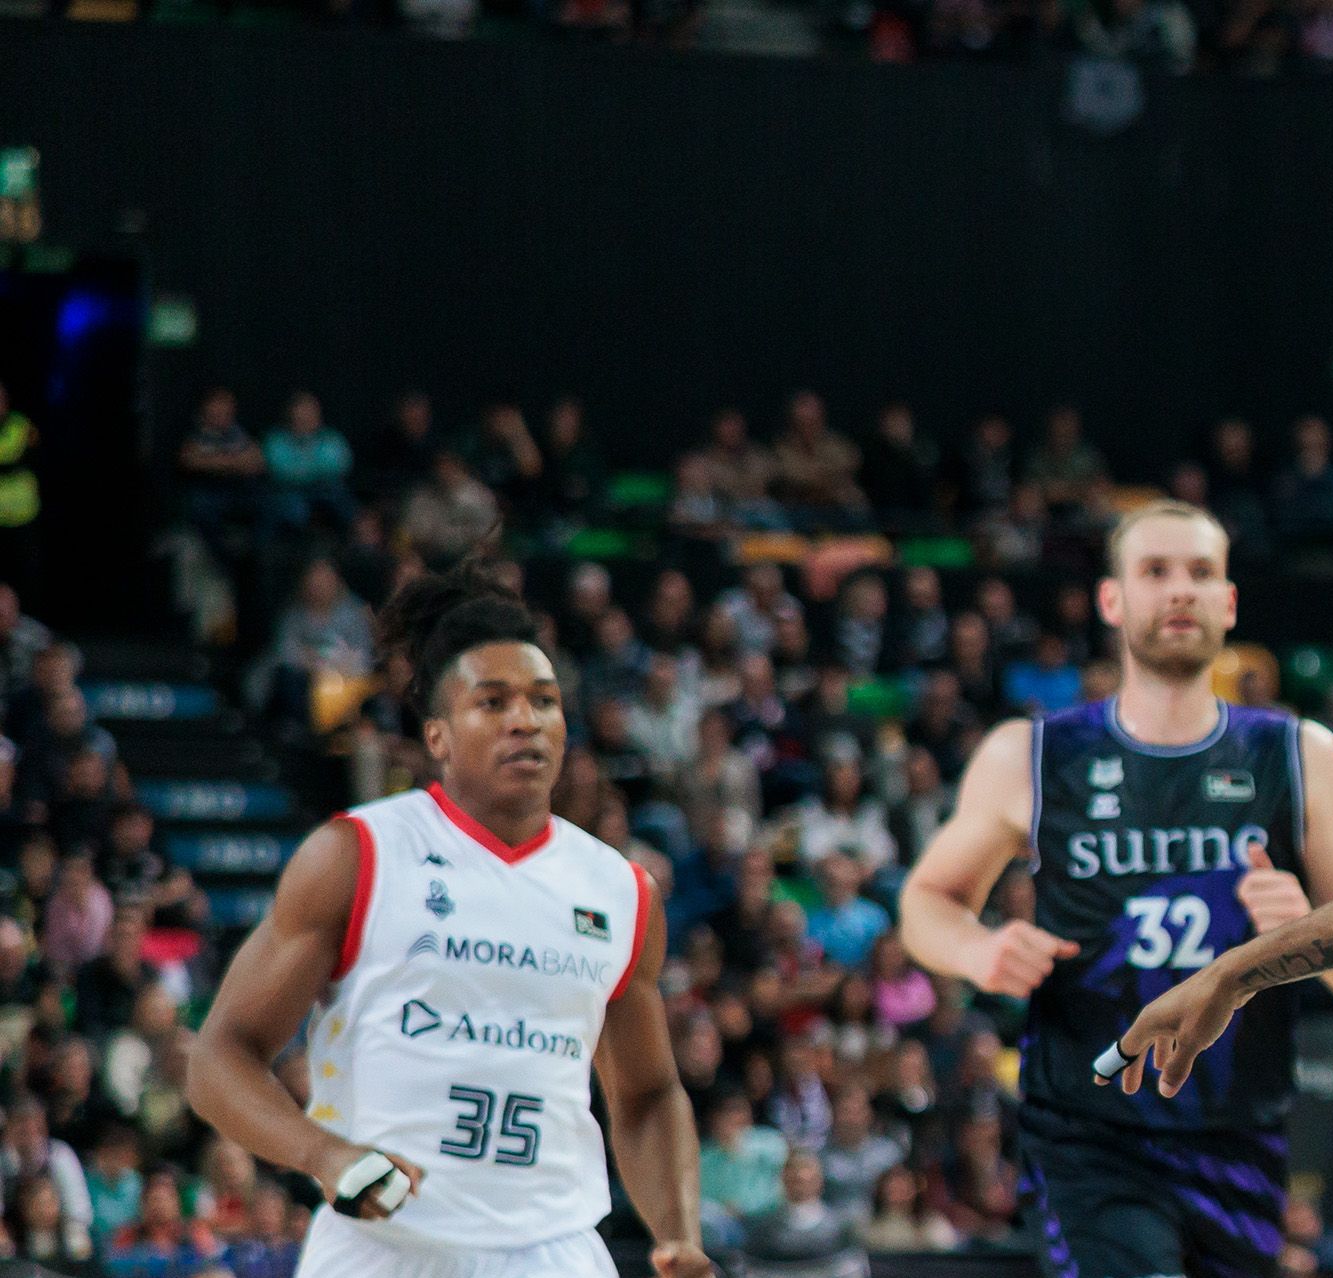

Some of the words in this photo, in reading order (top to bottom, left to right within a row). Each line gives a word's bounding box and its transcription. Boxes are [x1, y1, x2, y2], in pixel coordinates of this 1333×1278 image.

[446, 937, 612, 984] MORABANC
[1124, 895, 1214, 969] 32
[449, 1012, 582, 1060] Andorra
[440, 1084, 544, 1167] 35
